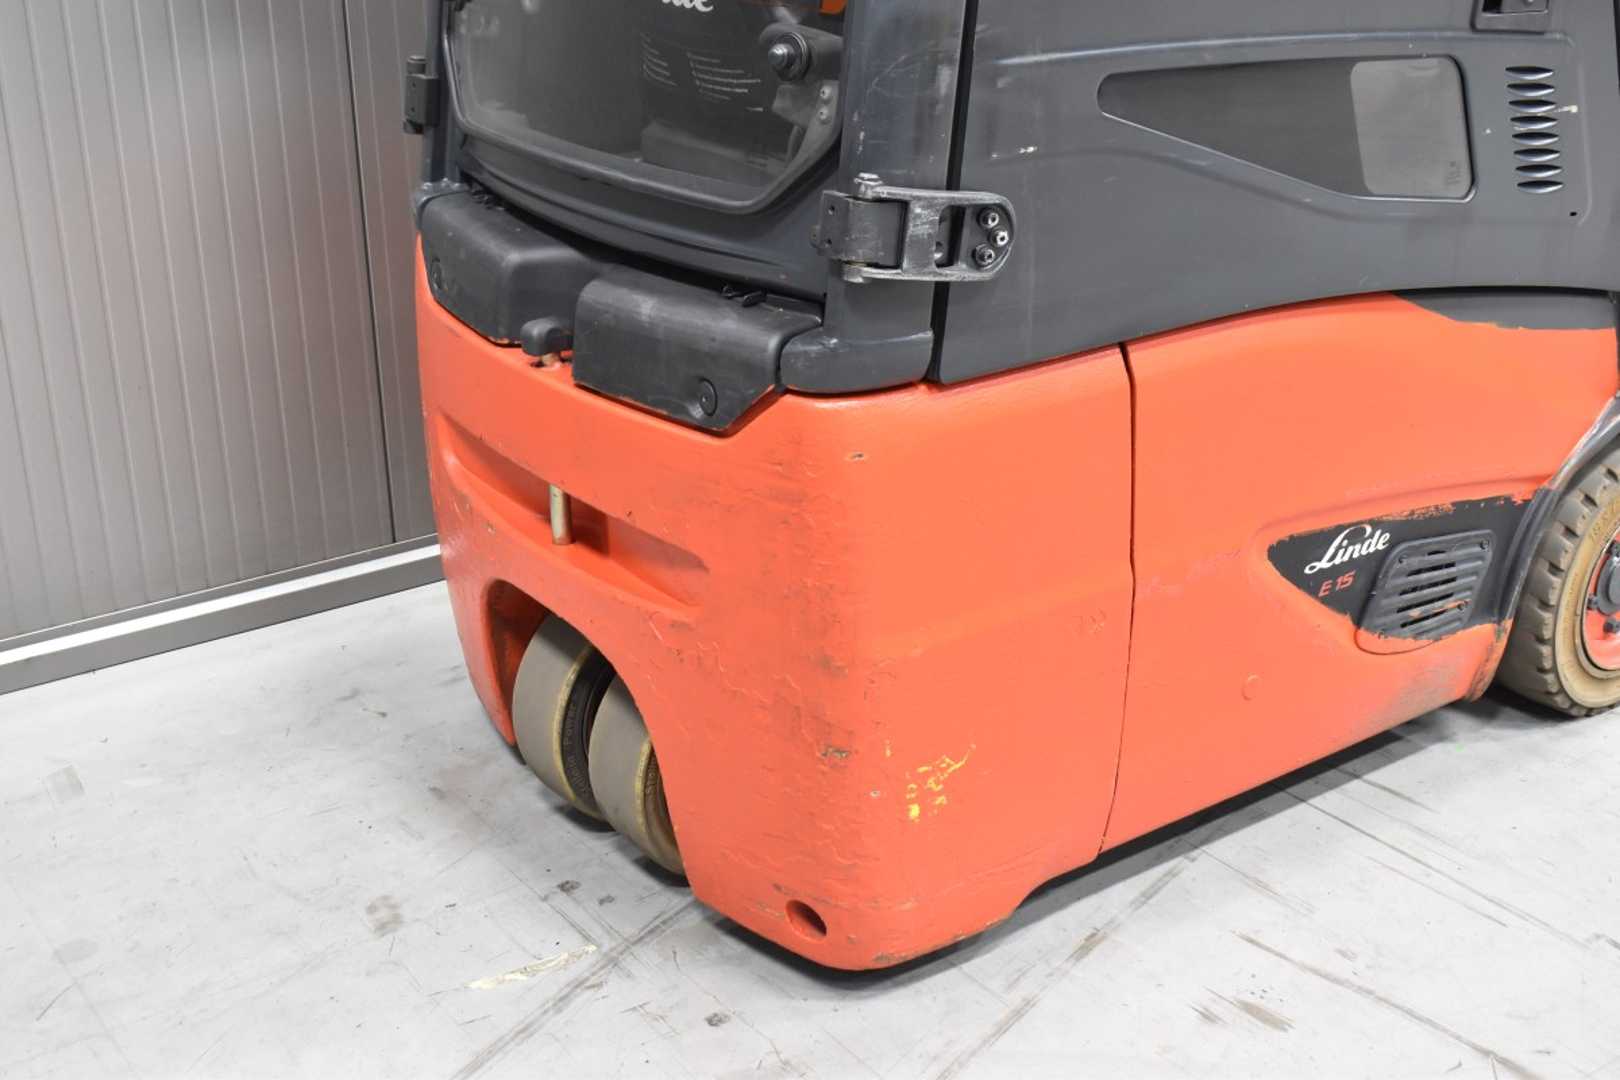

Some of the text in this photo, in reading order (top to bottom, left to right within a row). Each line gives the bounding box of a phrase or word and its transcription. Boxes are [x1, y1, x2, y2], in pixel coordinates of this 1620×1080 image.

[1304, 524, 1390, 574] Linde
[1318, 569, 1357, 597] E 15
